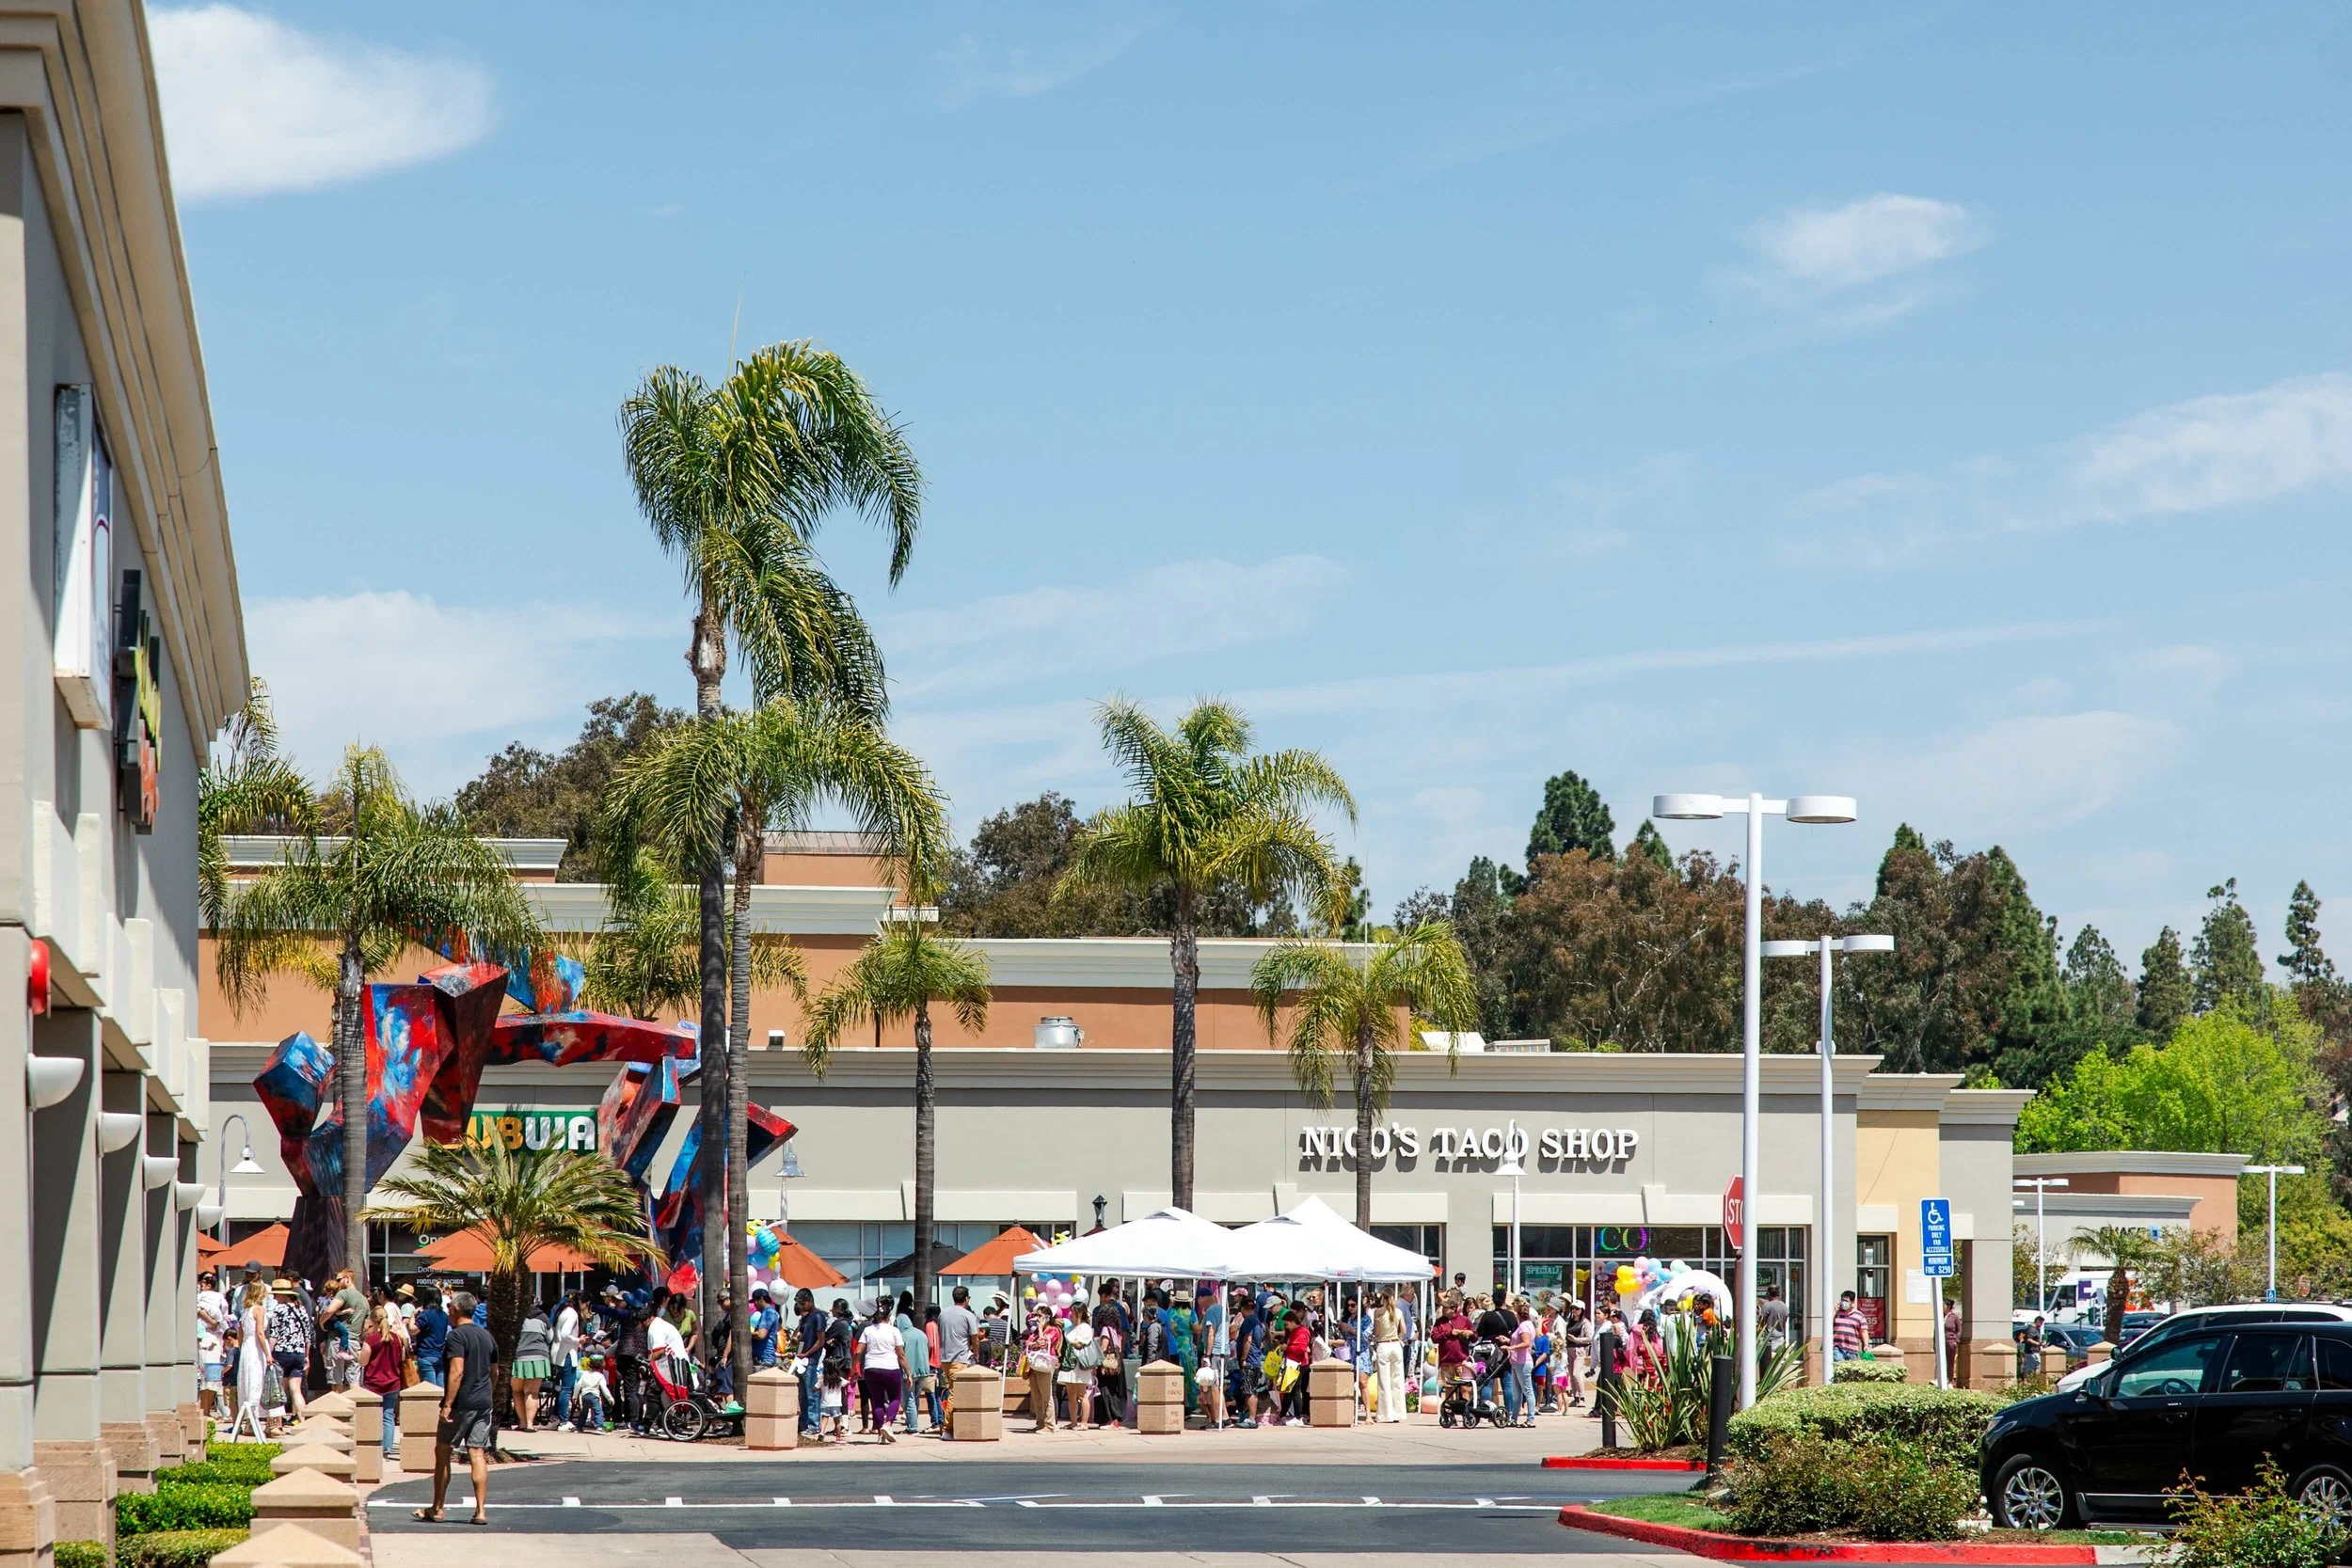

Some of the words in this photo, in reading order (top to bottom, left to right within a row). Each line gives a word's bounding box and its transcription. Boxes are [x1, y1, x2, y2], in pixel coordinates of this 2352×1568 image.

[465, 1117, 596, 1149] UBWA
[1302, 1122, 1421, 1158] NICO'S
[1433, 1127, 1530, 1158] TACO
[1541, 1127, 1640, 1159] SHOP
[1728, 1198, 1743, 1225] ST
[1928, 1257, 1948, 1265] MINIMUM
[1938, 1265, 1951, 1274] $250
